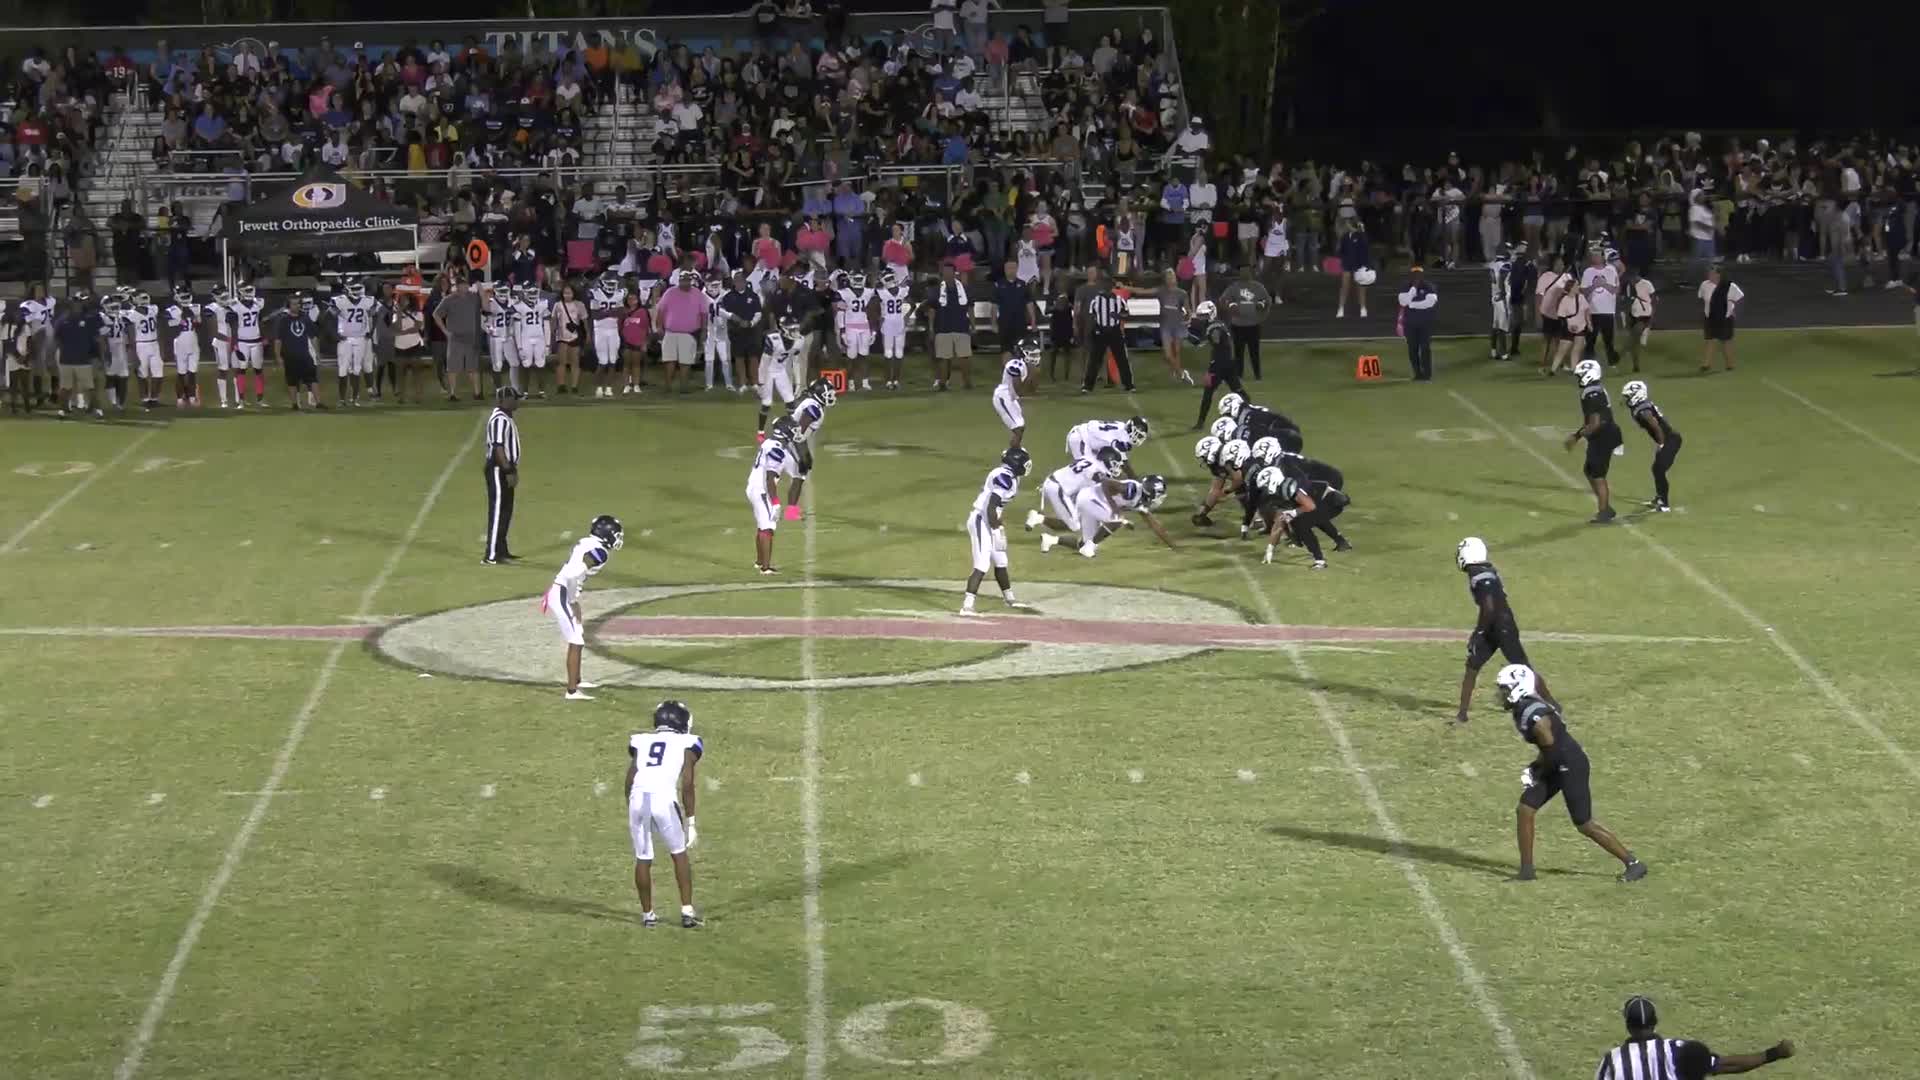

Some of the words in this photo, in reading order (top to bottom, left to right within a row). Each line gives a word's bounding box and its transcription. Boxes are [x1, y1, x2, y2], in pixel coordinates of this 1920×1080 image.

[113, 67, 126, 79] 19
[239, 219, 280, 234] Jewett
[282, 217, 361, 233] Orthopaedic
[365, 215, 401, 229] Clinic
[852, 300, 866, 313] 31
[886, 300, 902, 314] 82
[242, 311, 258, 327] 27
[347, 308, 364, 323] 72
[526, 311, 540, 325] 21
[140, 317, 156, 334] 30
[1362, 360, 1380, 376] 40
[646, 741, 667, 767] 9
[624, 997, 995, 1072] 50
